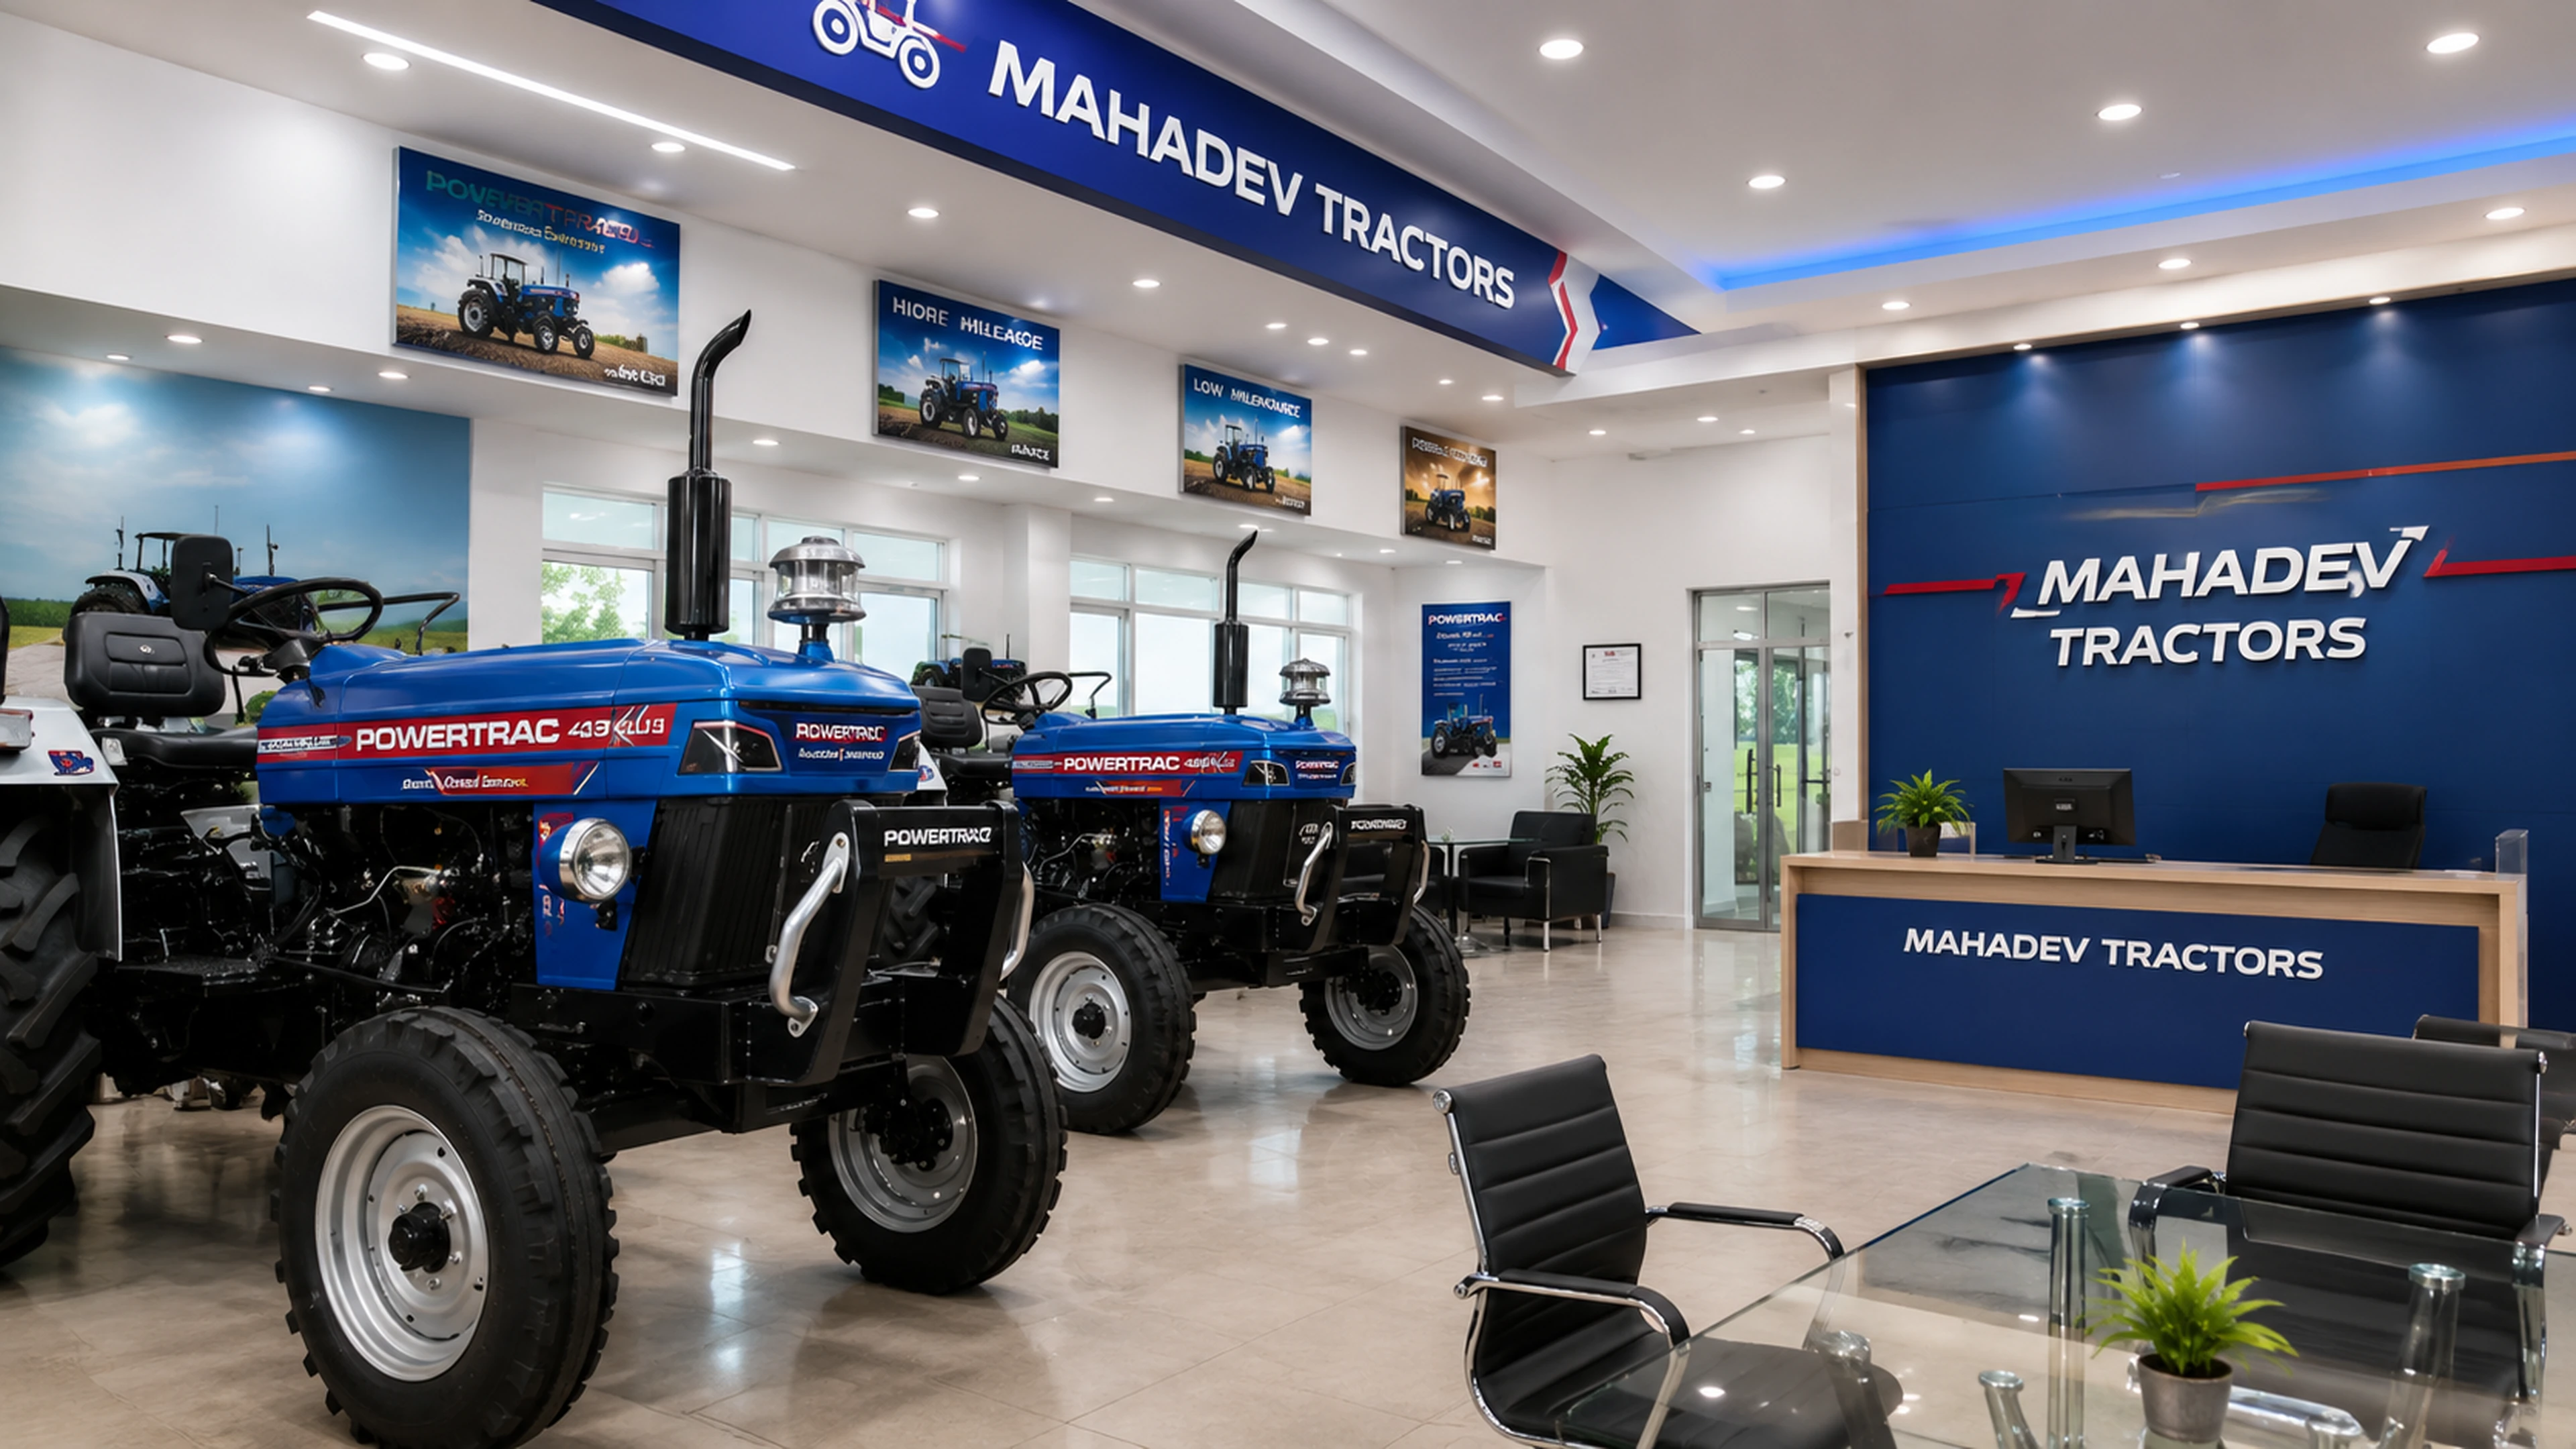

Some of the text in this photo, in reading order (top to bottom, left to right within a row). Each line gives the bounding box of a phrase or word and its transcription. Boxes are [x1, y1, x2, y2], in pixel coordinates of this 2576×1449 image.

[987, 40, 1515, 309] MAHADEV TRACTORS
[1193, 378, 1224, 397] LOW
[2038, 539, 2414, 605] MAHADEV
[2050, 617, 2366, 666] TRACTORS
[356, 718, 560, 751] POWERTRAC
[1063, 756, 1180, 771] POWERTRAC
[1904, 928, 2323, 979] MAHADEV TRACTORS
